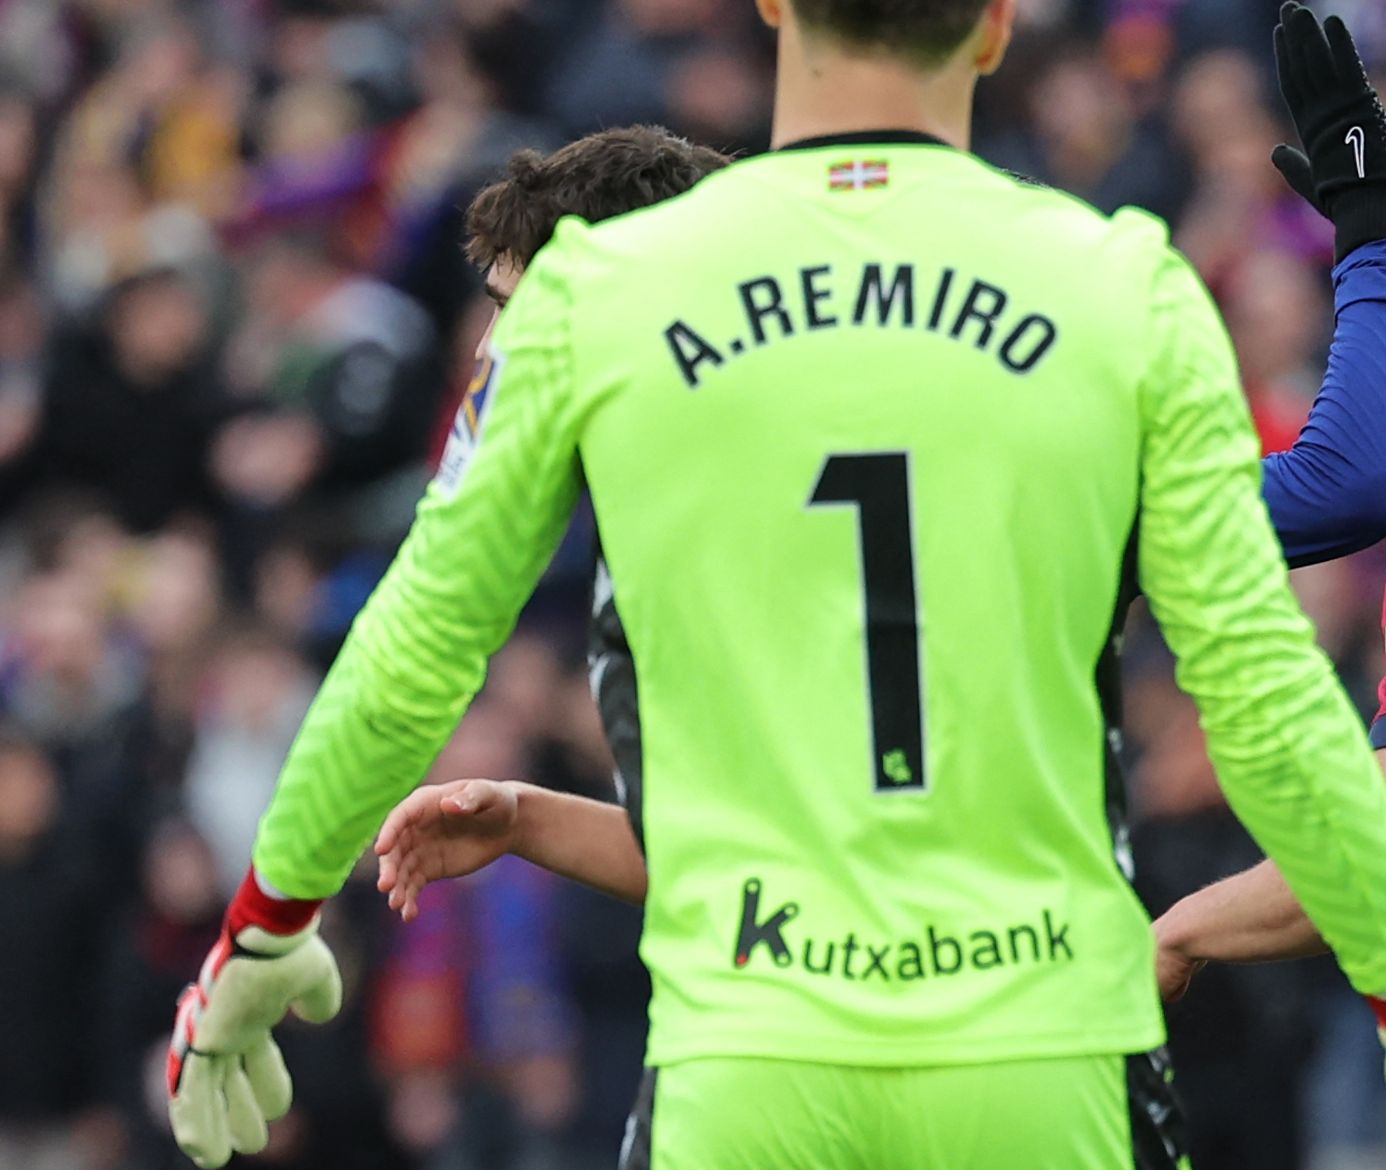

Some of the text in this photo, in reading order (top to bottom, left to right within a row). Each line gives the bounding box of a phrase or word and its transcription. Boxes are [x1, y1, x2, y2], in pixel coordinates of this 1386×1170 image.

[664, 263, 1058, 388] A.REMIRO
[805, 450, 928, 796] 1
[734, 879, 1074, 984] Kutxabank
